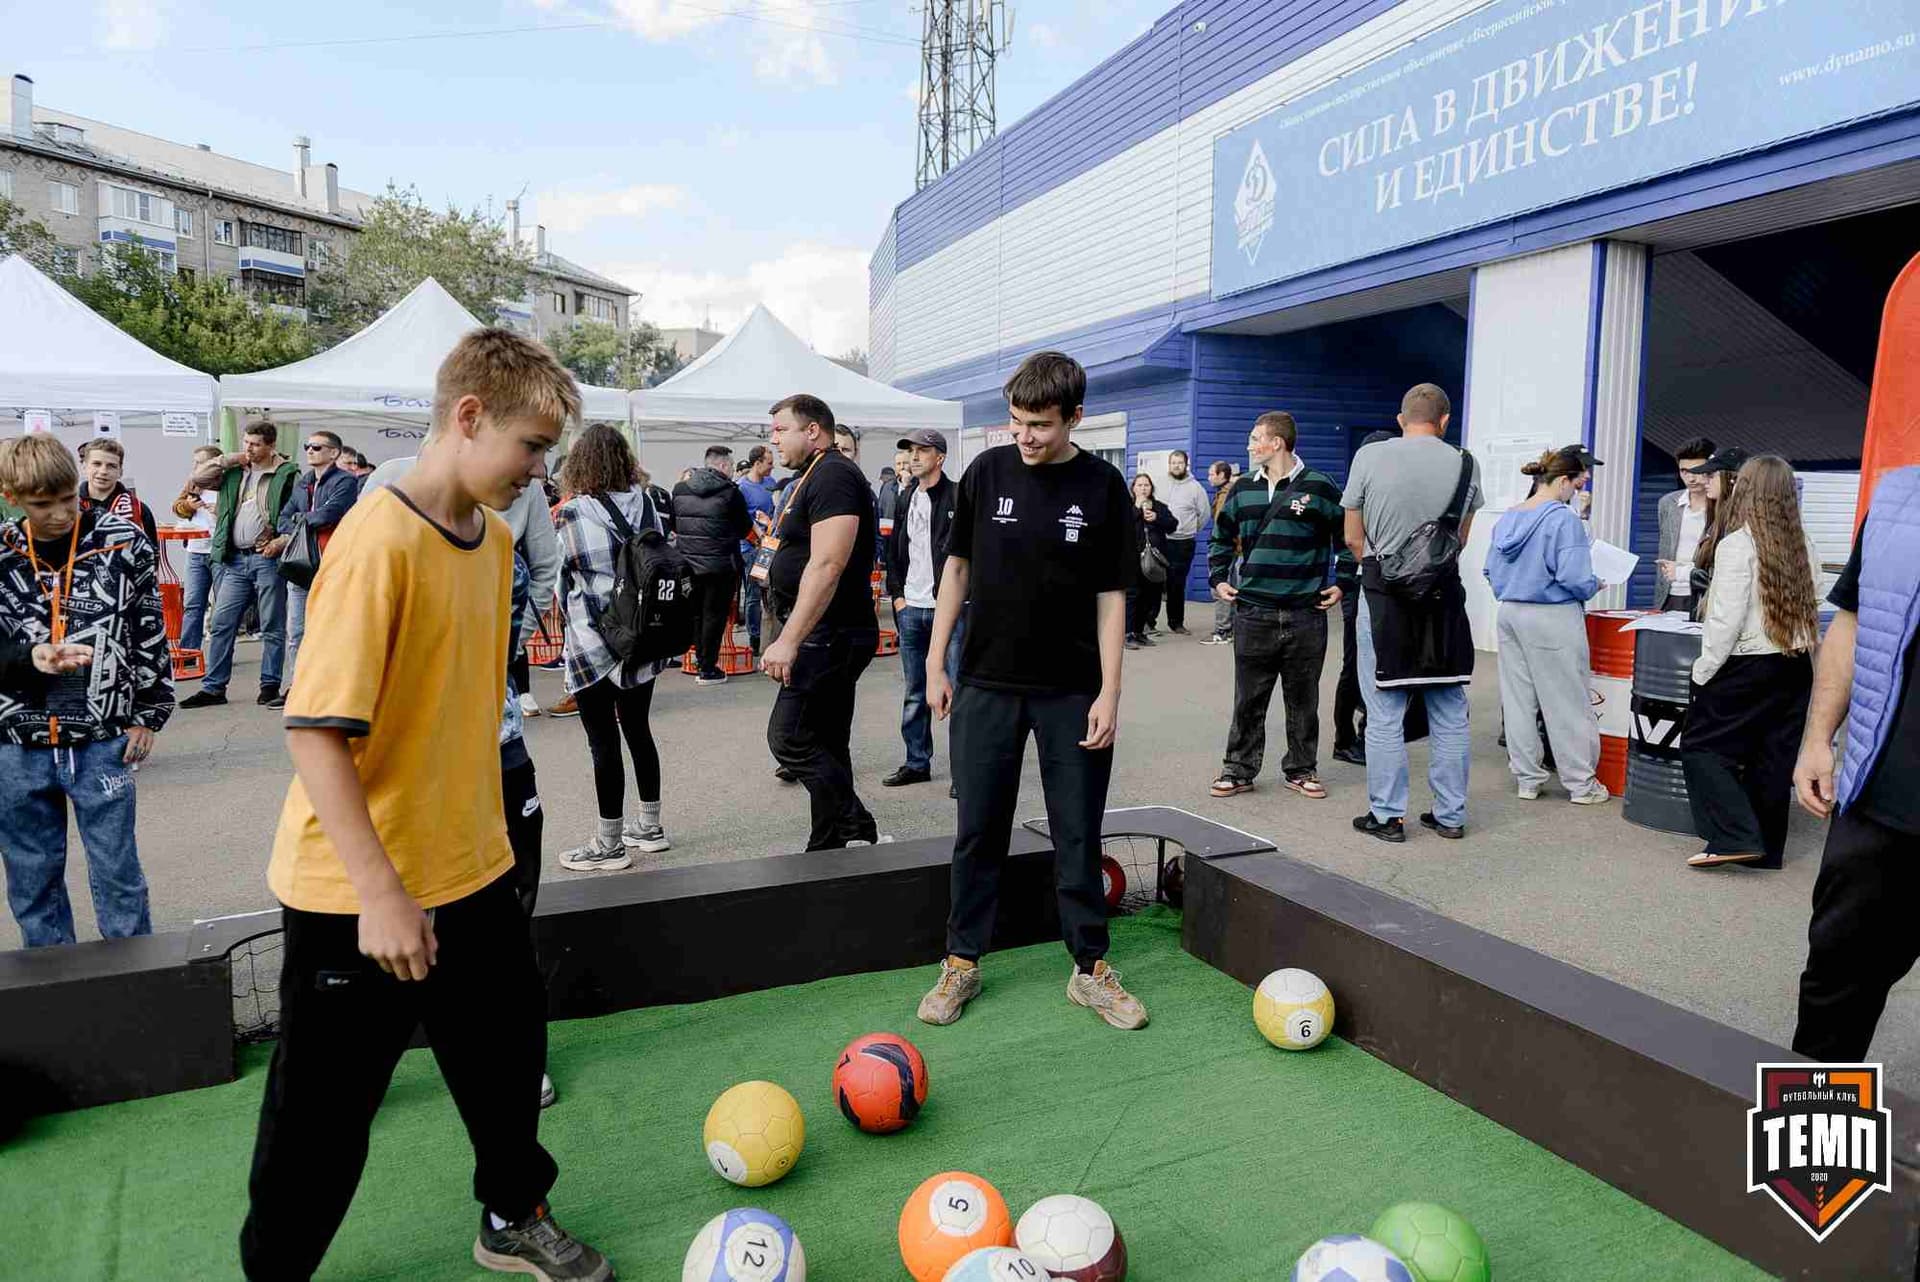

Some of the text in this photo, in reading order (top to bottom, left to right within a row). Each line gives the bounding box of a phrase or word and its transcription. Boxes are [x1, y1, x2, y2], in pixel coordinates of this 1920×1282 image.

[1778, 31, 1915, 87] www.dynamo.su
[1318, 0, 1792, 177] СИЛА В ДВИЖЕН
[1375, 61, 1698, 214] И ЕДИНСТВЕ!
[997, 497, 1014, 516] 10
[657, 578, 676, 601] 22
[948, 1196, 970, 1212] 5
[742, 1238, 768, 1268] 12
[1007, 1257, 1036, 1280] 10
